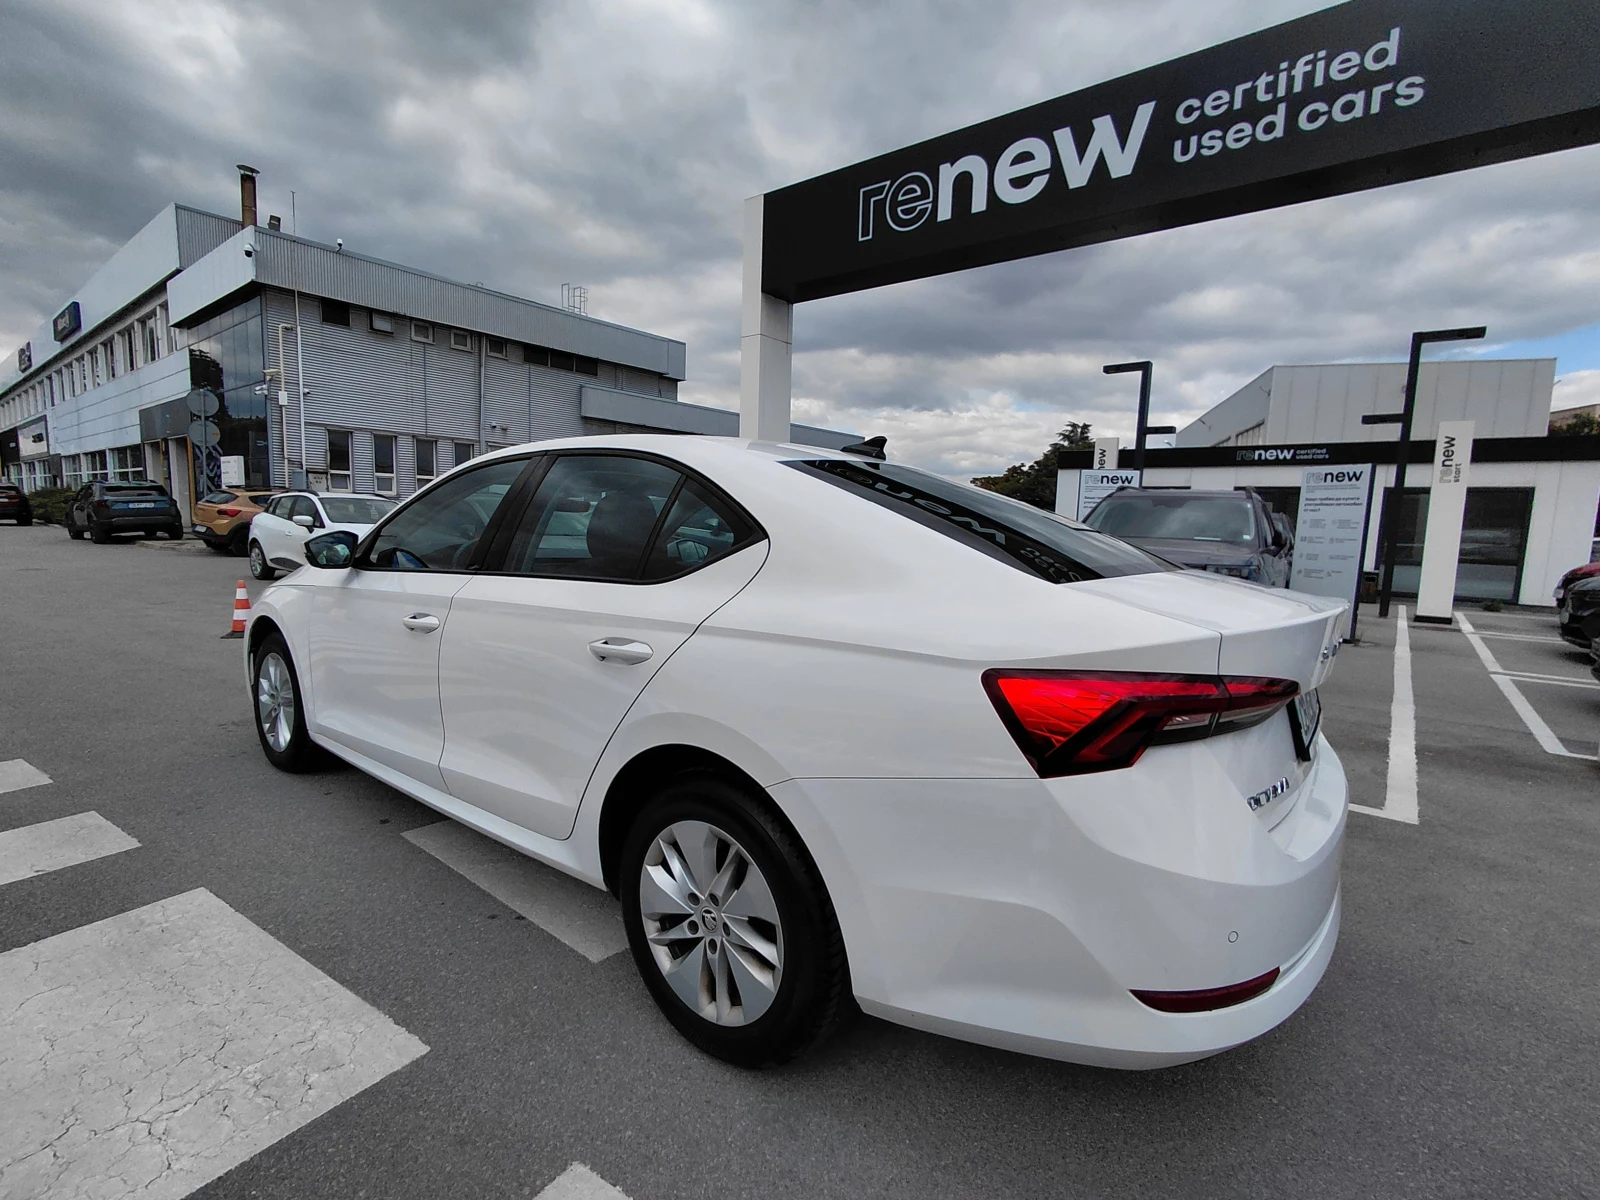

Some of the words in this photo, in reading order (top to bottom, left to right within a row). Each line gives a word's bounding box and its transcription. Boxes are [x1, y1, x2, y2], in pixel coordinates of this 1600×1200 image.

[1174, 27, 1401, 126] certified
[1173, 102, 1287, 164] used
[1297, 75, 1426, 134] cars
[857, 100, 1156, 242] renew
[1236, 448, 1295, 461] renew
[1439, 435, 1456, 484] renew
[1084, 474, 1134, 485] renew
[1306, 470, 1364, 484] renew
[1453, 462, 1462, 483] start
